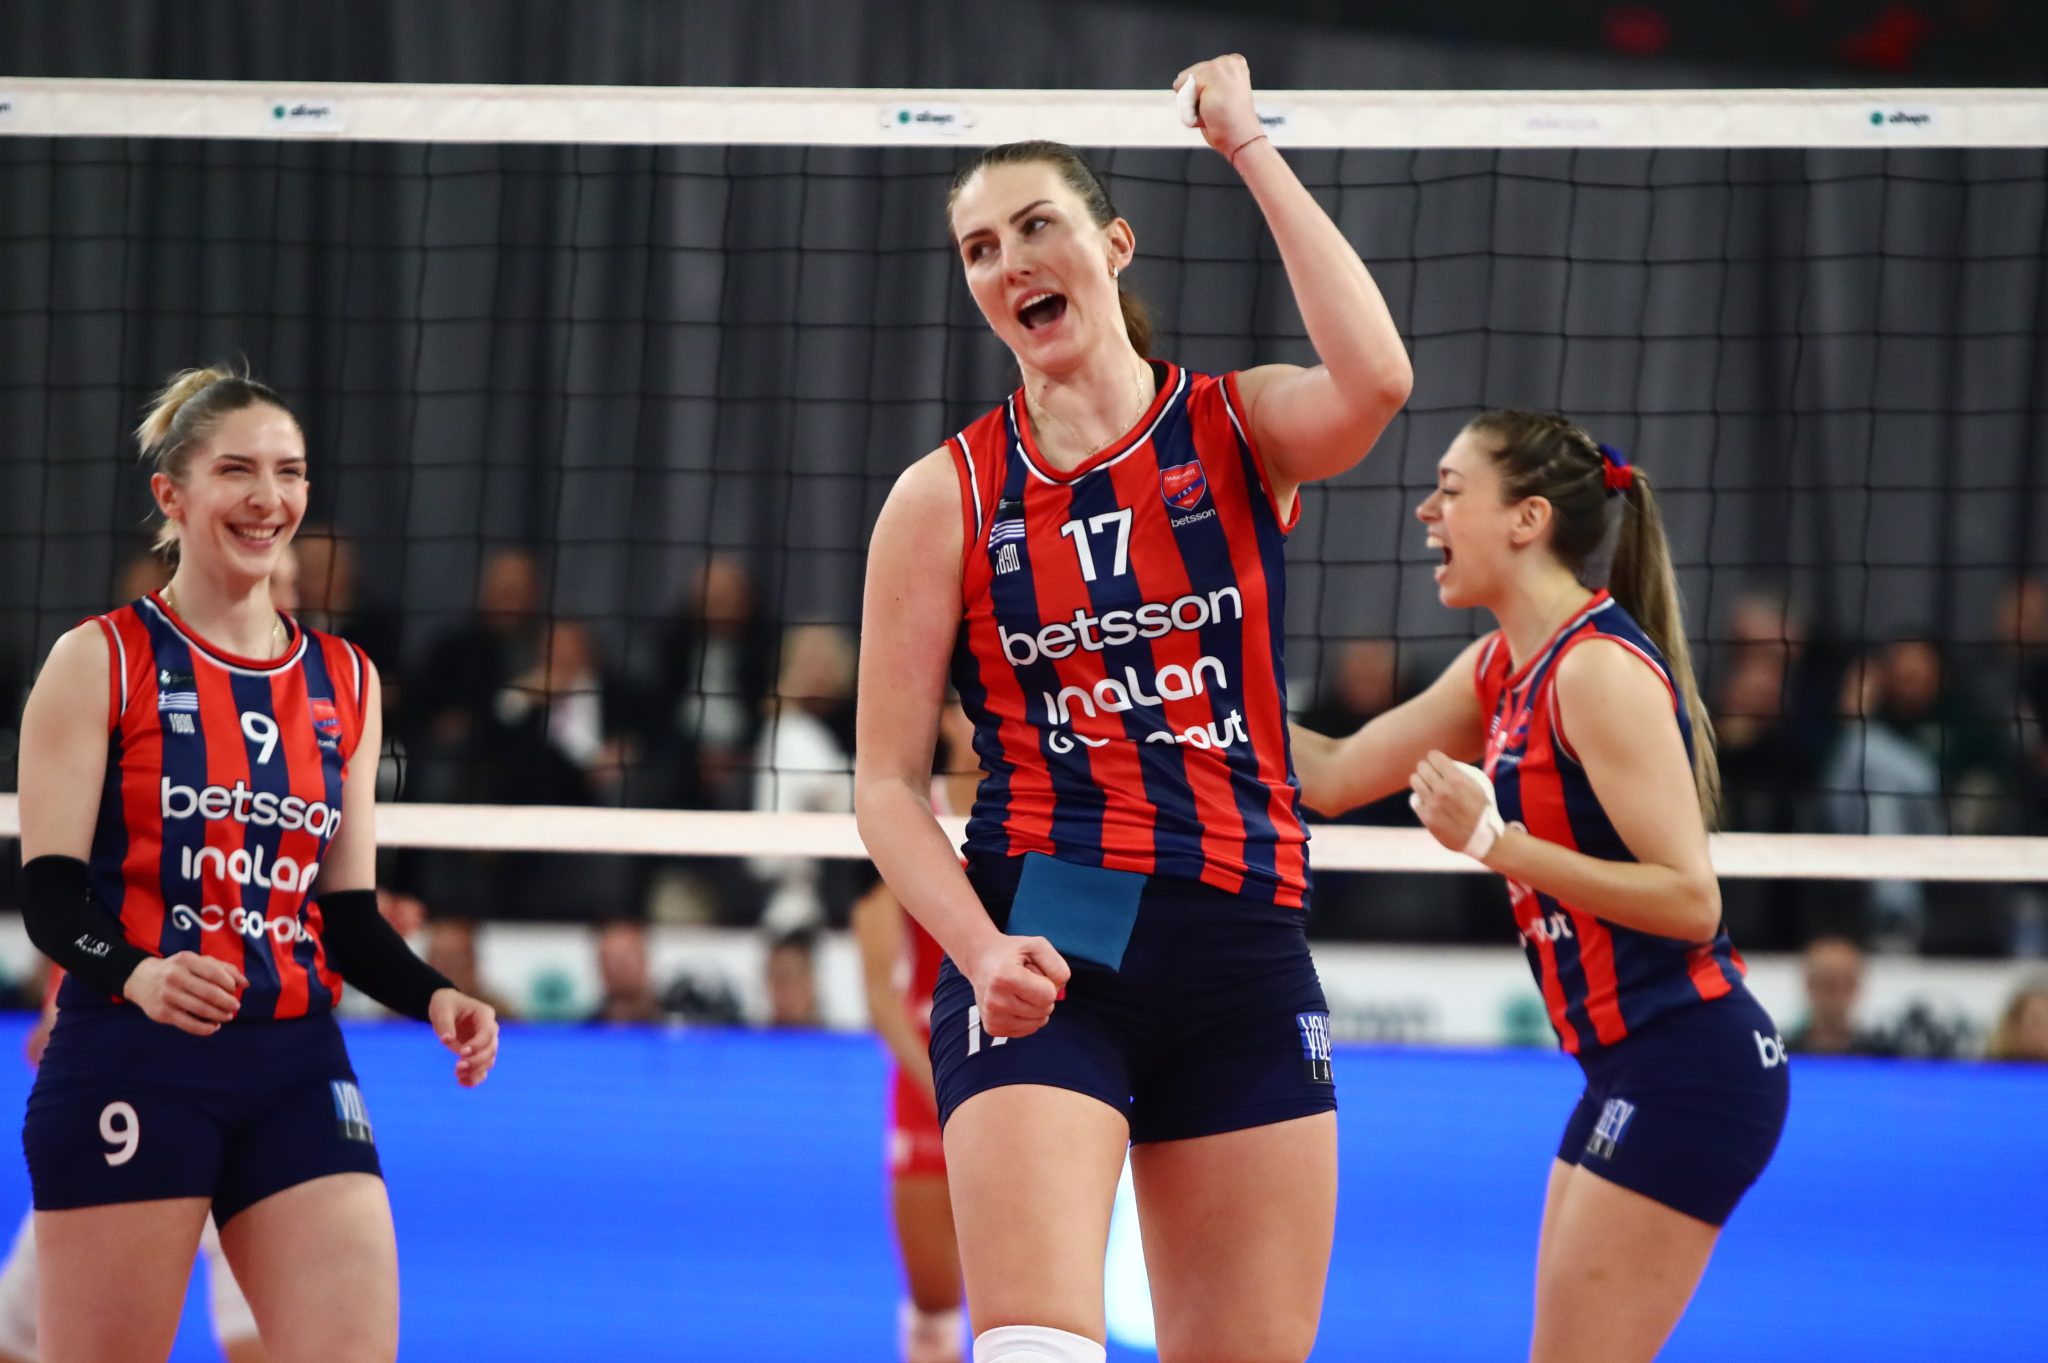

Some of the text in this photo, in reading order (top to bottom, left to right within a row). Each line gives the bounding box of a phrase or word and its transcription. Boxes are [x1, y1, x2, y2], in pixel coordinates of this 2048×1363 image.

[1060, 507, 1133, 582] 17
[1171, 508, 1216, 528] betsson
[997, 586, 1243, 666] betsson
[240, 711, 280, 765] 9
[161, 776, 342, 839] betsson
[967, 1004, 1009, 1057] 1
[1753, 1029, 1789, 1069] be
[99, 1100, 140, 1167] 9
